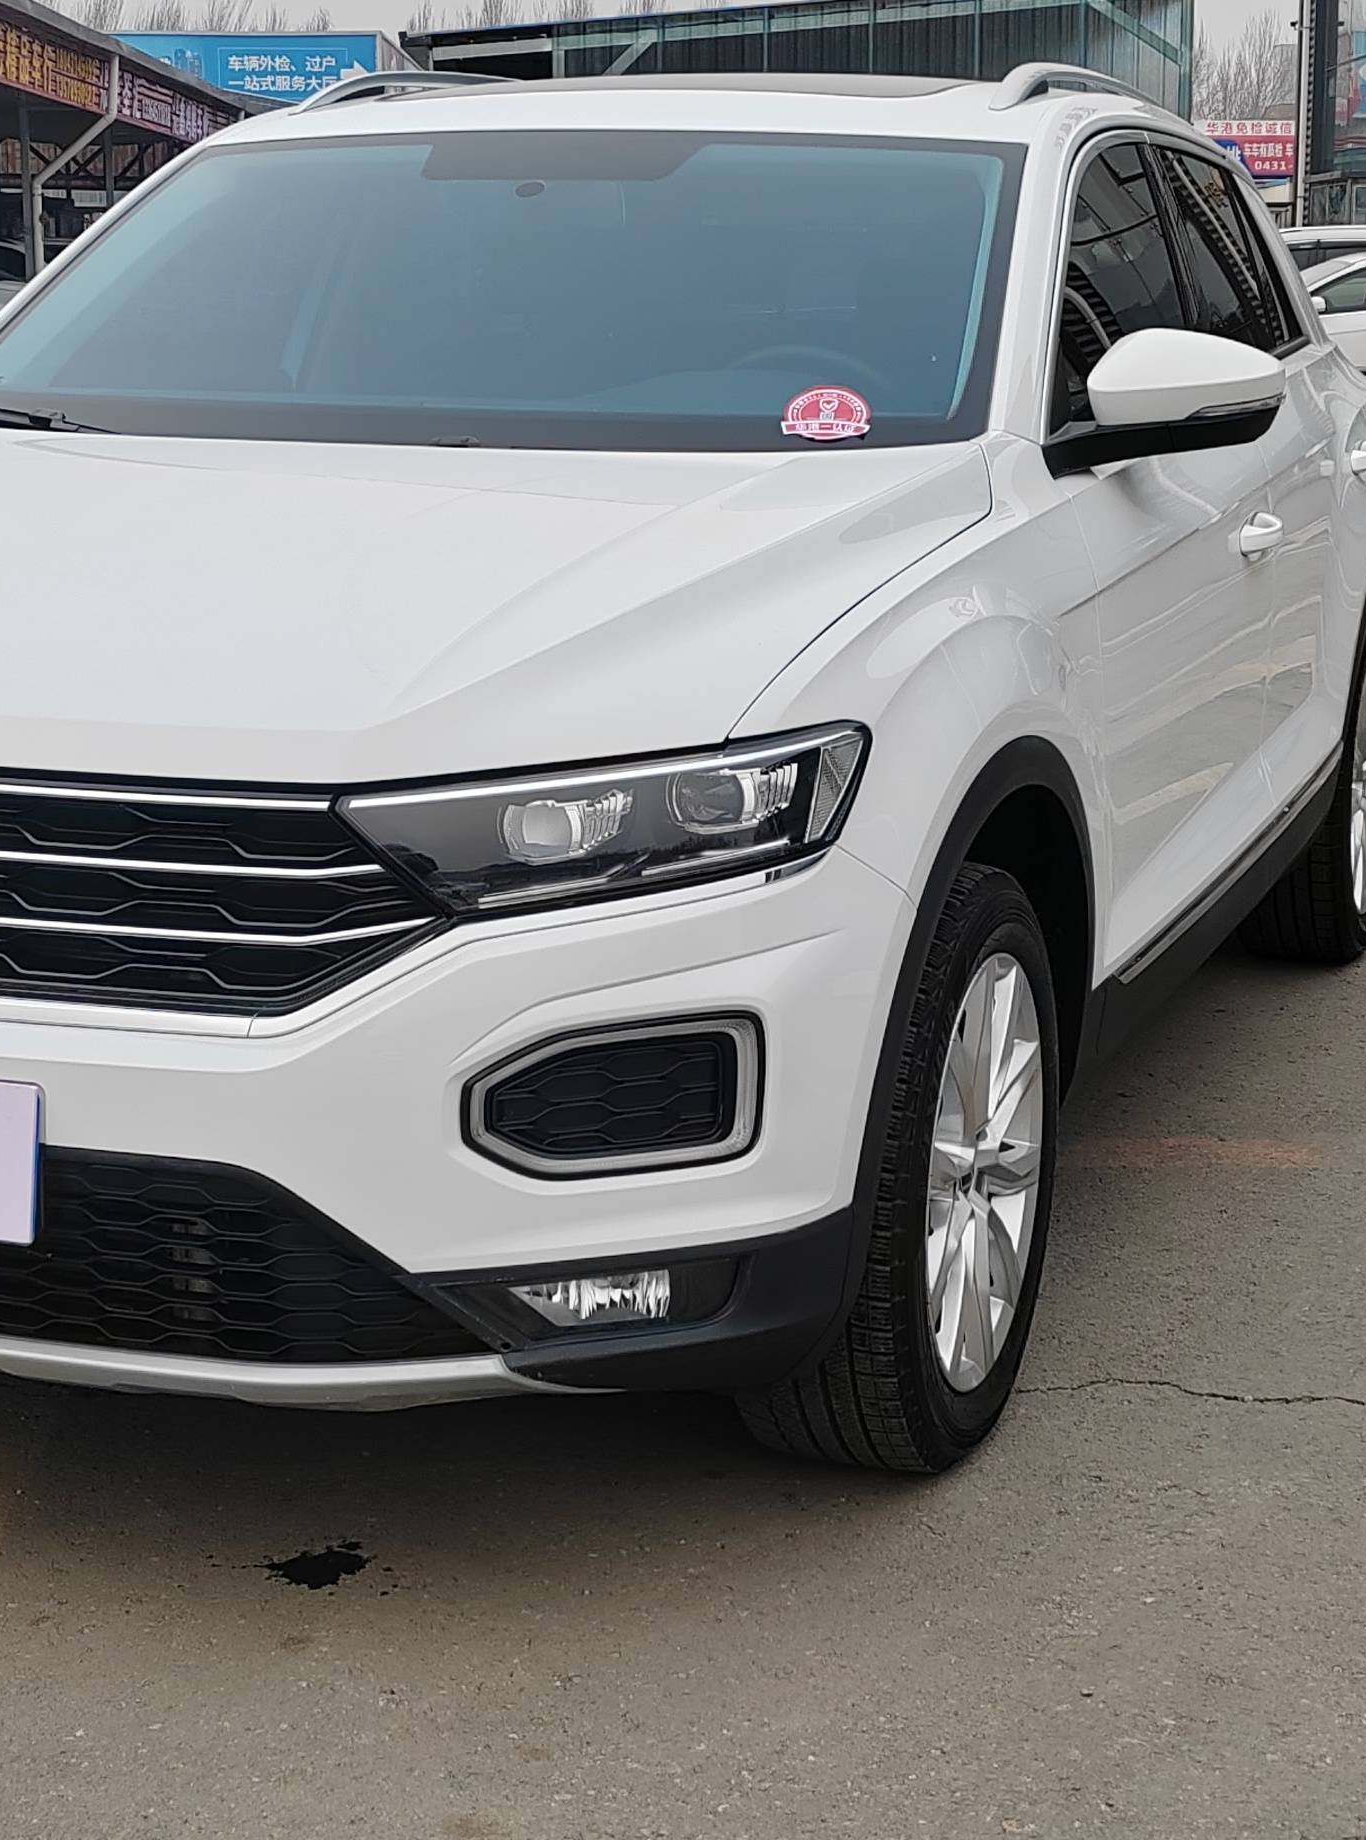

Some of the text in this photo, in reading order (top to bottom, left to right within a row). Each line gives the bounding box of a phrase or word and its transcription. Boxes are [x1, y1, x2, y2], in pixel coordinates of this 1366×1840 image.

[228, 55, 335, 73] 车辆外检、过户
